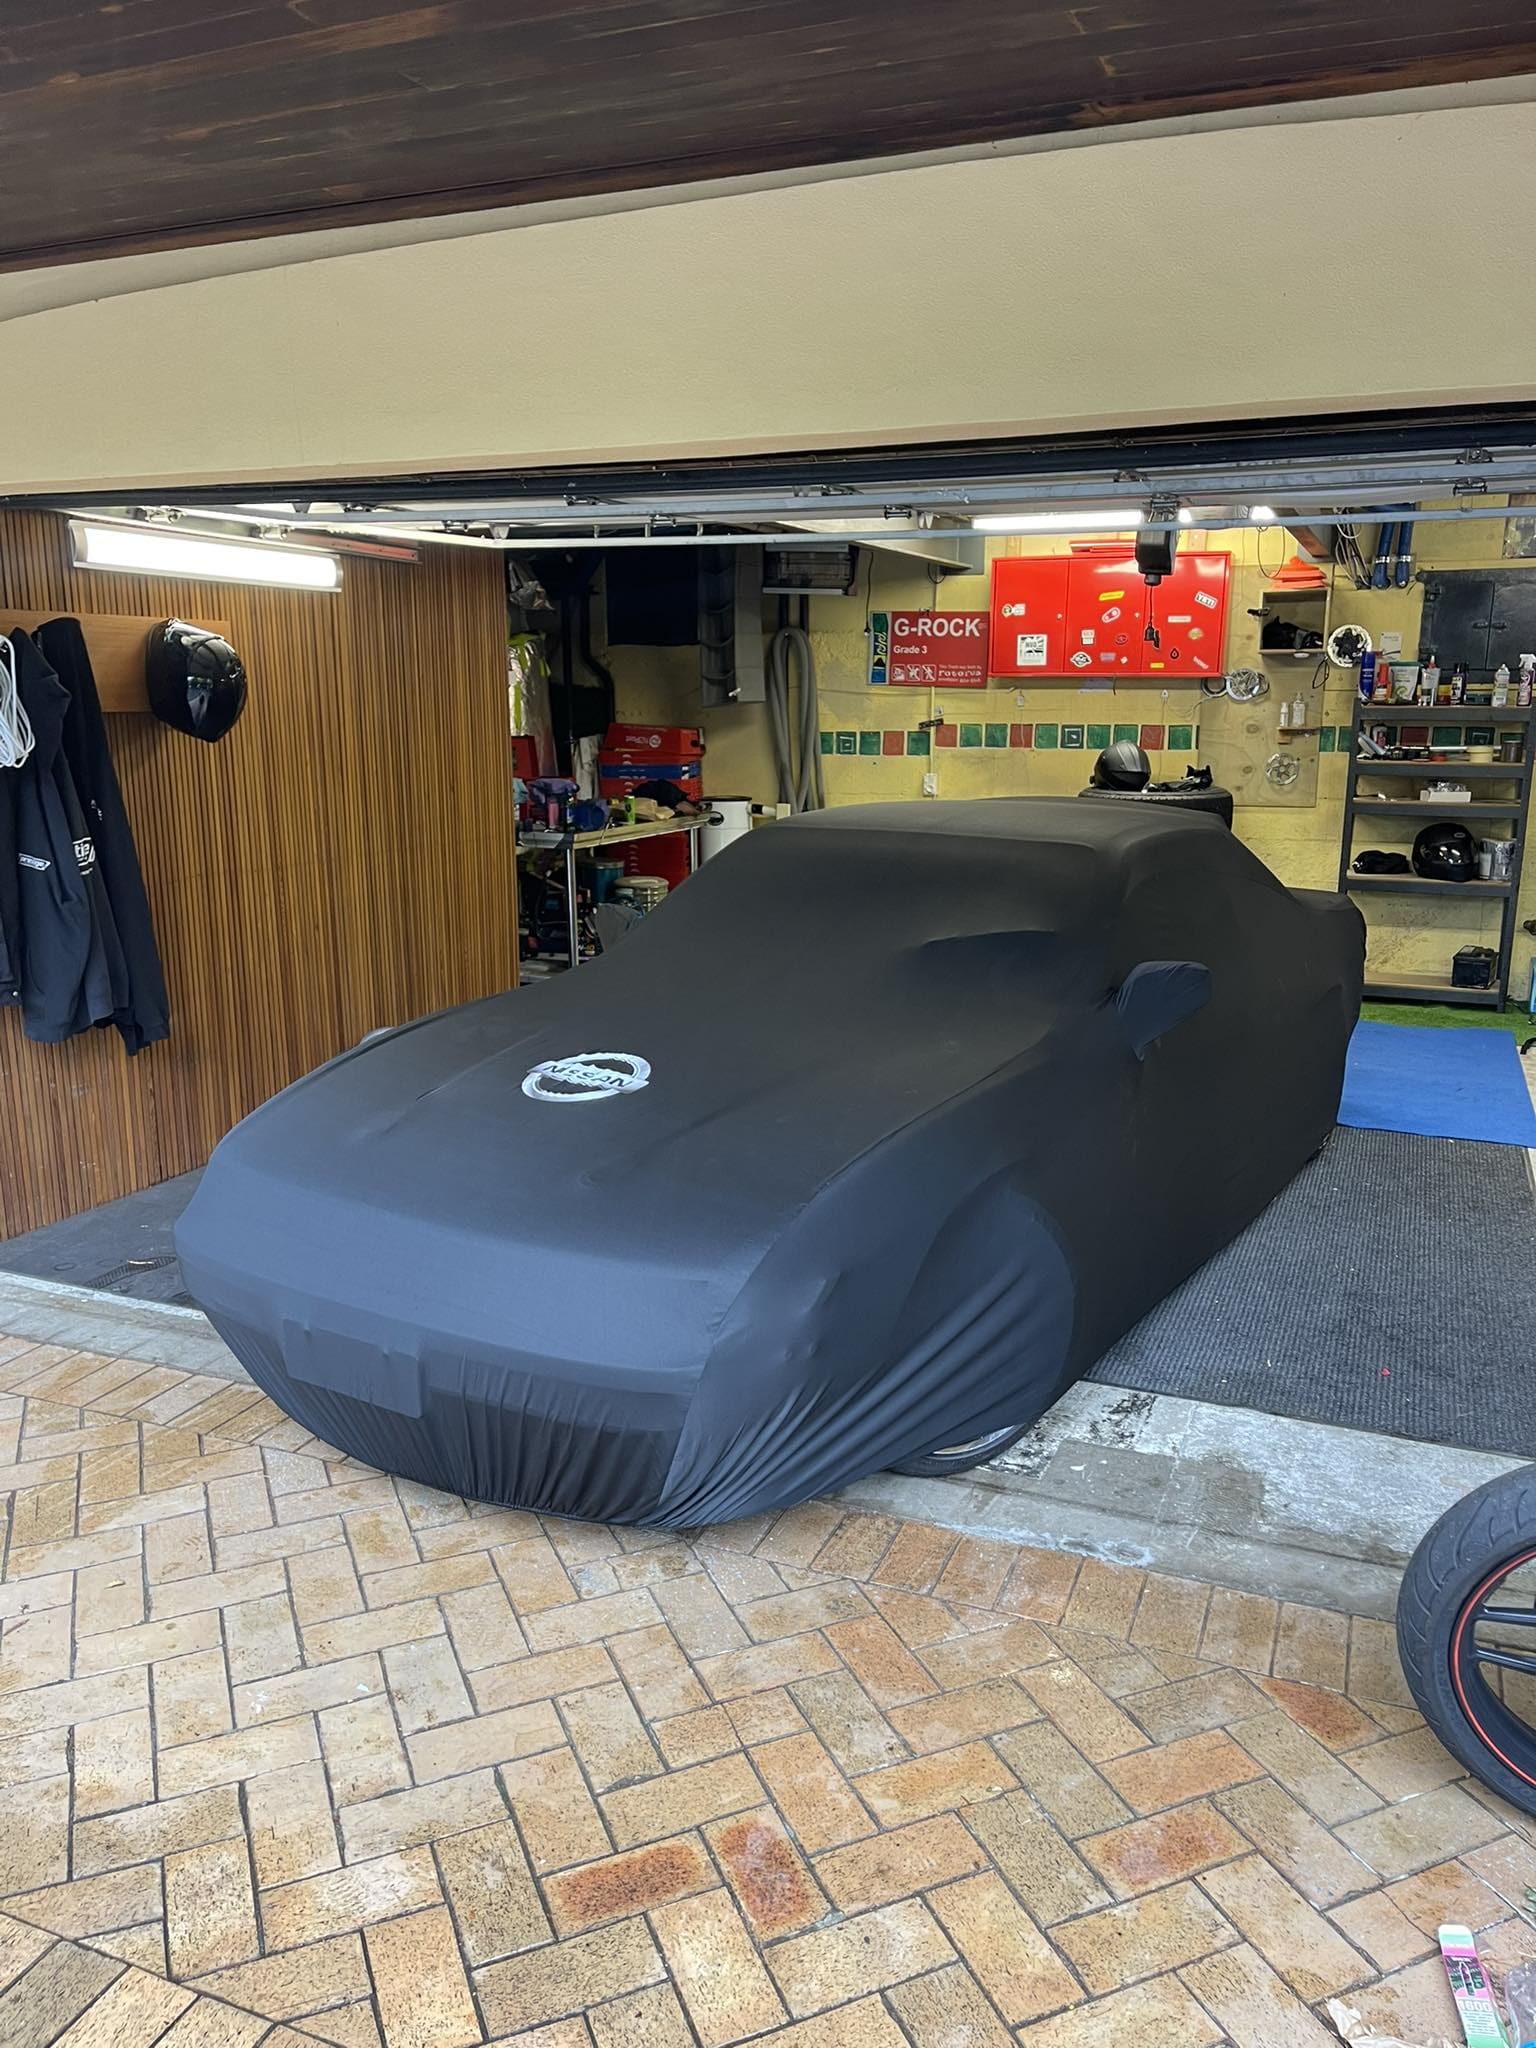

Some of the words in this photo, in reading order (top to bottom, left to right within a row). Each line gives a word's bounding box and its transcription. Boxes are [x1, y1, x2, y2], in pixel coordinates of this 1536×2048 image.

[893, 618, 981, 637] G-ROCK
[893, 645, 920, 654] Grade
[921, 645, 928, 654] 3
[544, 1065, 632, 1088] NISSAN
